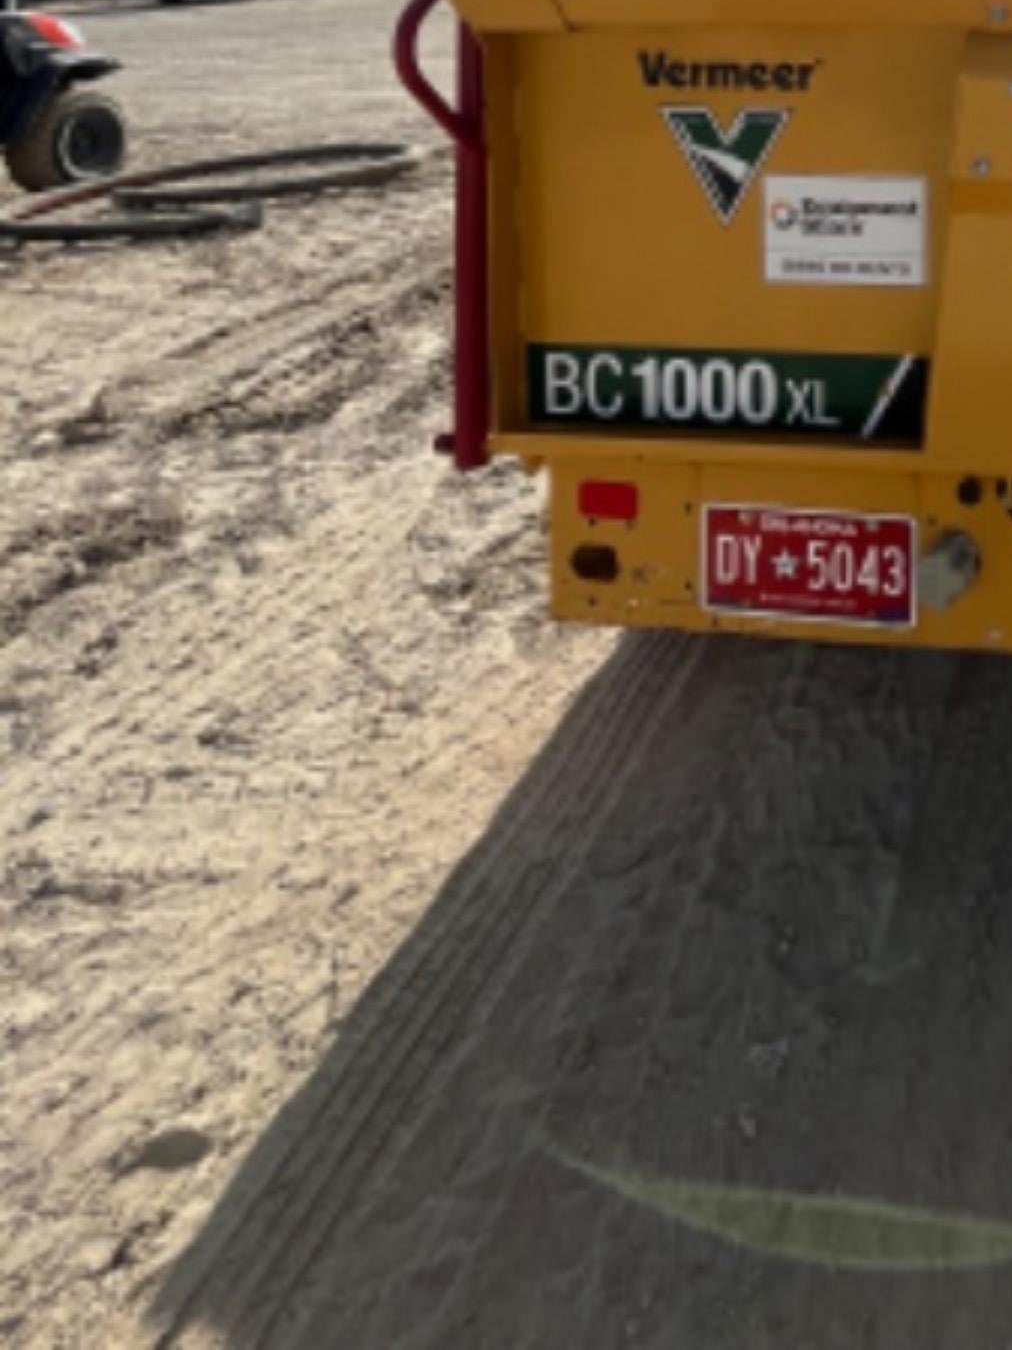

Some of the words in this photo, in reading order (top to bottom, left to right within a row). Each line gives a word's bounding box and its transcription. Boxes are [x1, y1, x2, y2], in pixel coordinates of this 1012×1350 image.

[637, 50, 815, 91] Vermeer
[785, 377, 841, 427] XL
[715, 534, 763, 586] DY
[807, 540, 906, 597] 5043
